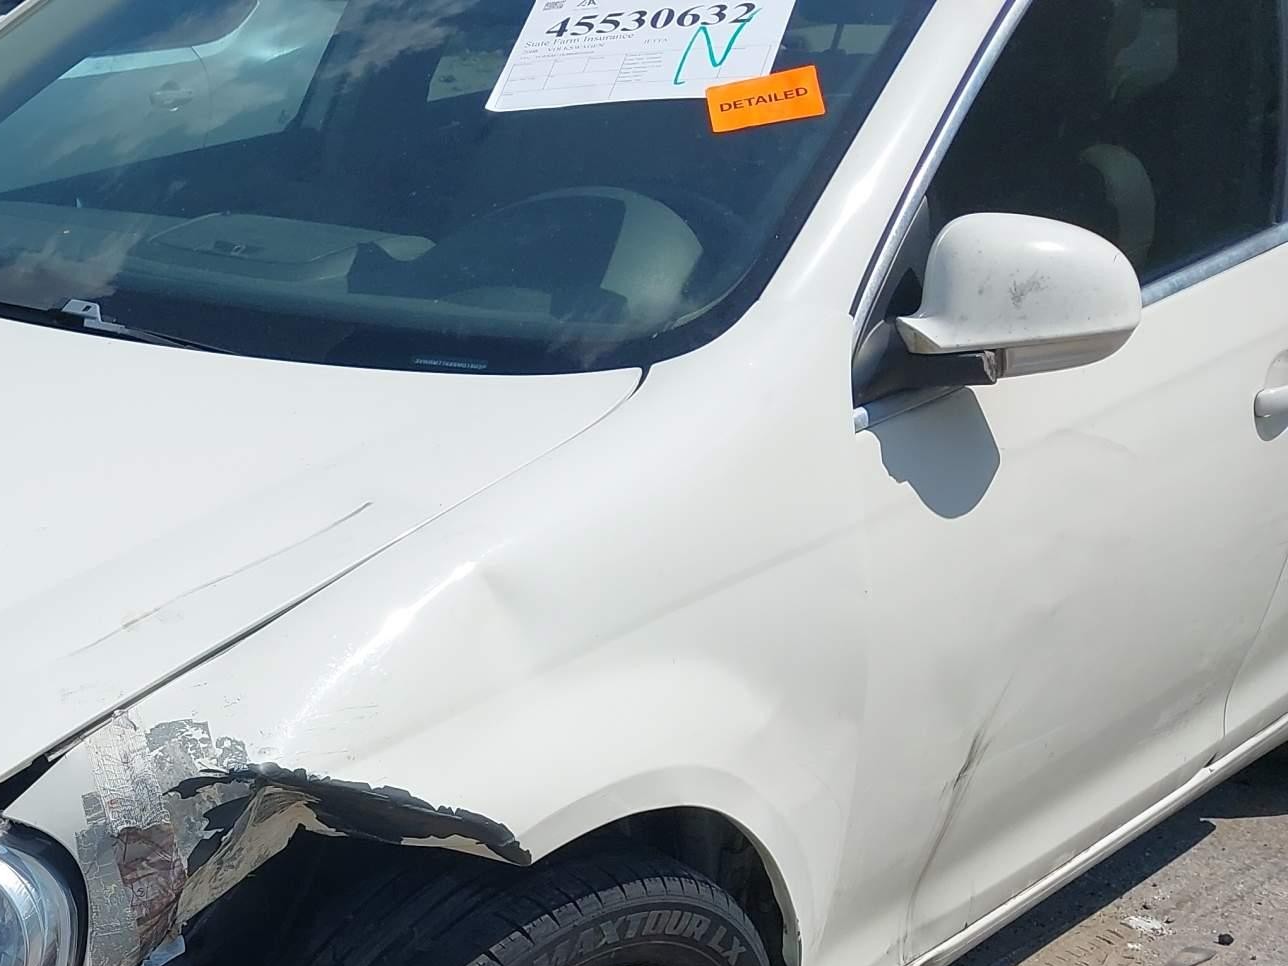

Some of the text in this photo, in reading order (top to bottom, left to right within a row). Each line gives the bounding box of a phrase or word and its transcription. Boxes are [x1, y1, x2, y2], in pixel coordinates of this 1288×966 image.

[545, 2, 756, 38] 45530632
[524, 33, 635, 48] State Farm Insurance
[719, 87, 809, 113] DETAILED
